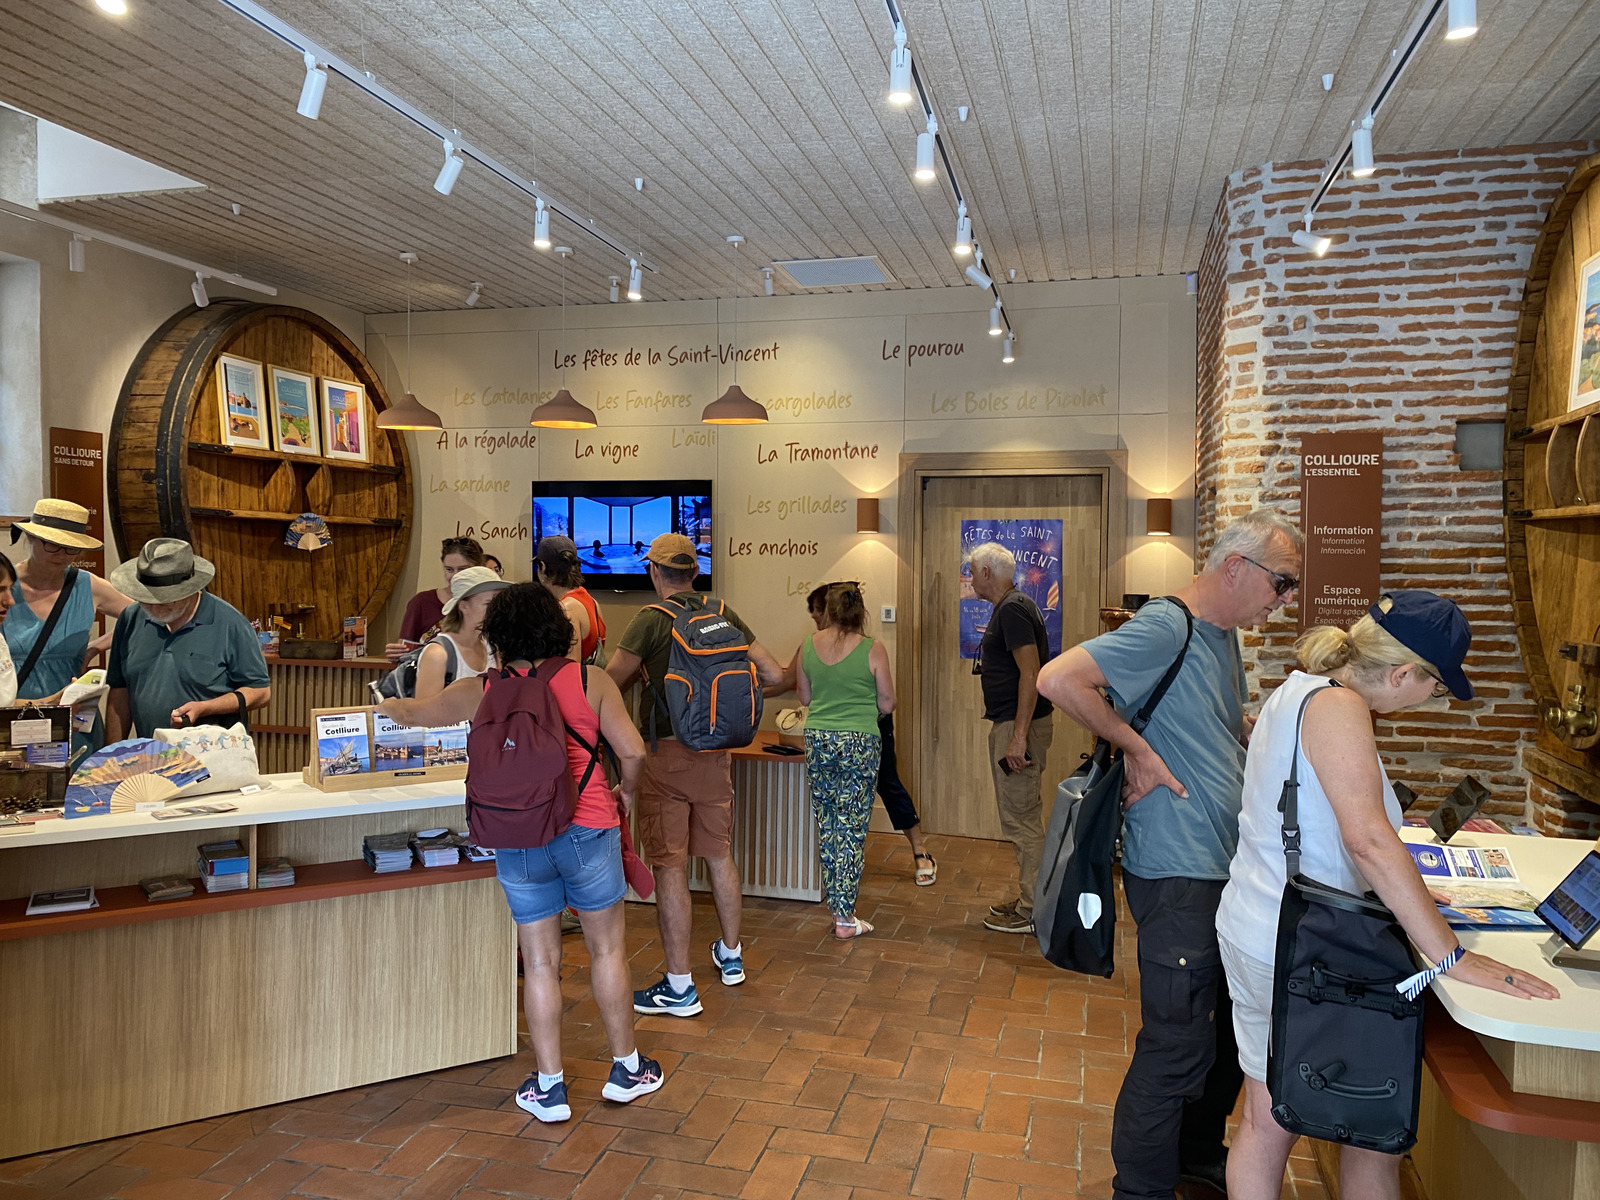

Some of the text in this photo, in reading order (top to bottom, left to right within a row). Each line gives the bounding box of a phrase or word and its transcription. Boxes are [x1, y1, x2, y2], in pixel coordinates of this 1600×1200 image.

[555, 342, 780, 370] Les fêtes de la Saint-Vincent
[882, 339, 965, 366] Le pourou
[454, 386, 553, 407] Les Catalanes
[596, 389, 692, 411] Les Fanfares
[765, 390, 852, 417] cargolades
[930, 384, 1108, 414] Les Boles de Picolat
[436, 430, 536, 455] A la régalade
[671, 427, 716, 449] L'aïoli
[54, 445, 102, 460] COLLIOURE
[575, 439, 639, 464] La vigne
[757, 441, 879, 464] La Tramontane
[1304, 454, 1380, 467] COLLIOURE
[54, 457, 94, 467] SANS DETOUR
[1304, 468, 1361, 477] L'ESSENTIEL
[430, 474, 511, 493] La sardane
[747, 494, 848, 520] Les grillades
[456, 521, 528, 541] La Sanch
[964, 526, 994, 544] FÊTES
[996, 530, 1005, 540] de
[1021, 526, 1053, 541] SAINT
[1313, 525, 1374, 535] Information
[729, 536, 818, 558] Les anchois
[1320, 546, 1366, 556] Información
[1321, 537, 1365, 546] Information
[71, 560, 97, 569] outique
[787, 575, 811, 597] Les
[1323, 585, 1361, 596] Espace
[1314, 596, 1370, 607] numérique
[1314, 617, 1344, 626] Espacio
[1318, 607, 1365, 617] Digital space
[325, 727, 360, 735] Cotlliure
